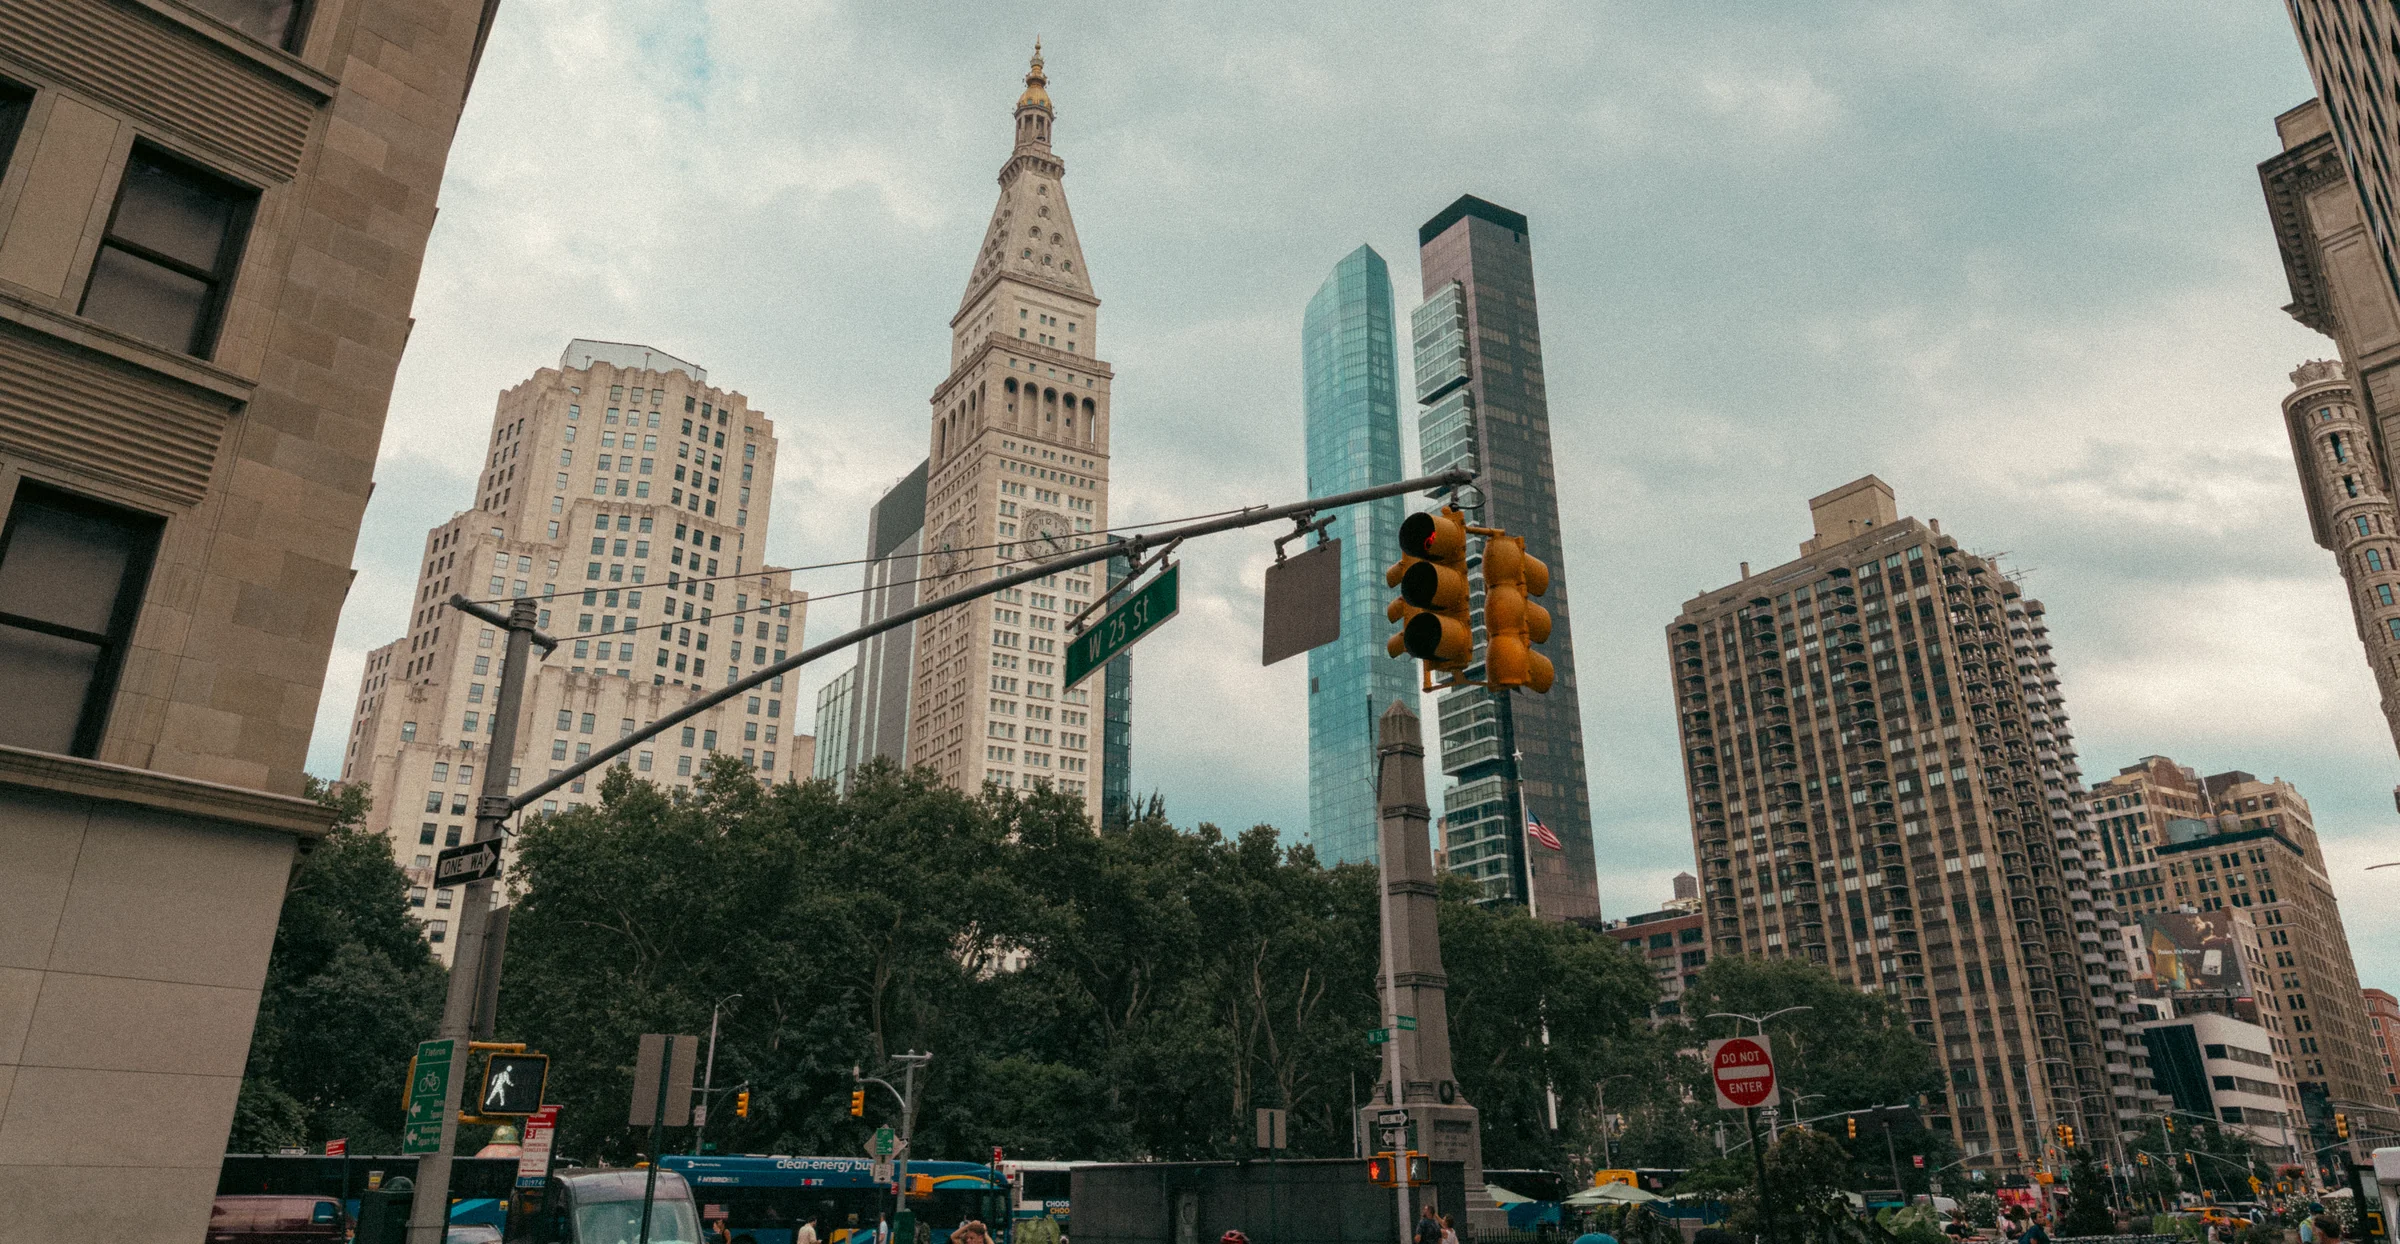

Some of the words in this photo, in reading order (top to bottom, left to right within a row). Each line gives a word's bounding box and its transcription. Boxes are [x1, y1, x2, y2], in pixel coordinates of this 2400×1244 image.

[1090, 630, 1102, 662] W
[1108, 612, 1126, 649] 25
[1133, 595, 1148, 631] St
[444, 858, 463, 875] ONE
[471, 852, 491, 870] WAY
[1376, 1031, 1382, 1041] 25
[1722, 1053, 1736, 1064] DO
[1740, 1051, 1759, 1062] NOT
[1730, 1081, 1763, 1094] ENTER
[776, 1160, 852, 1172] clean-energy
